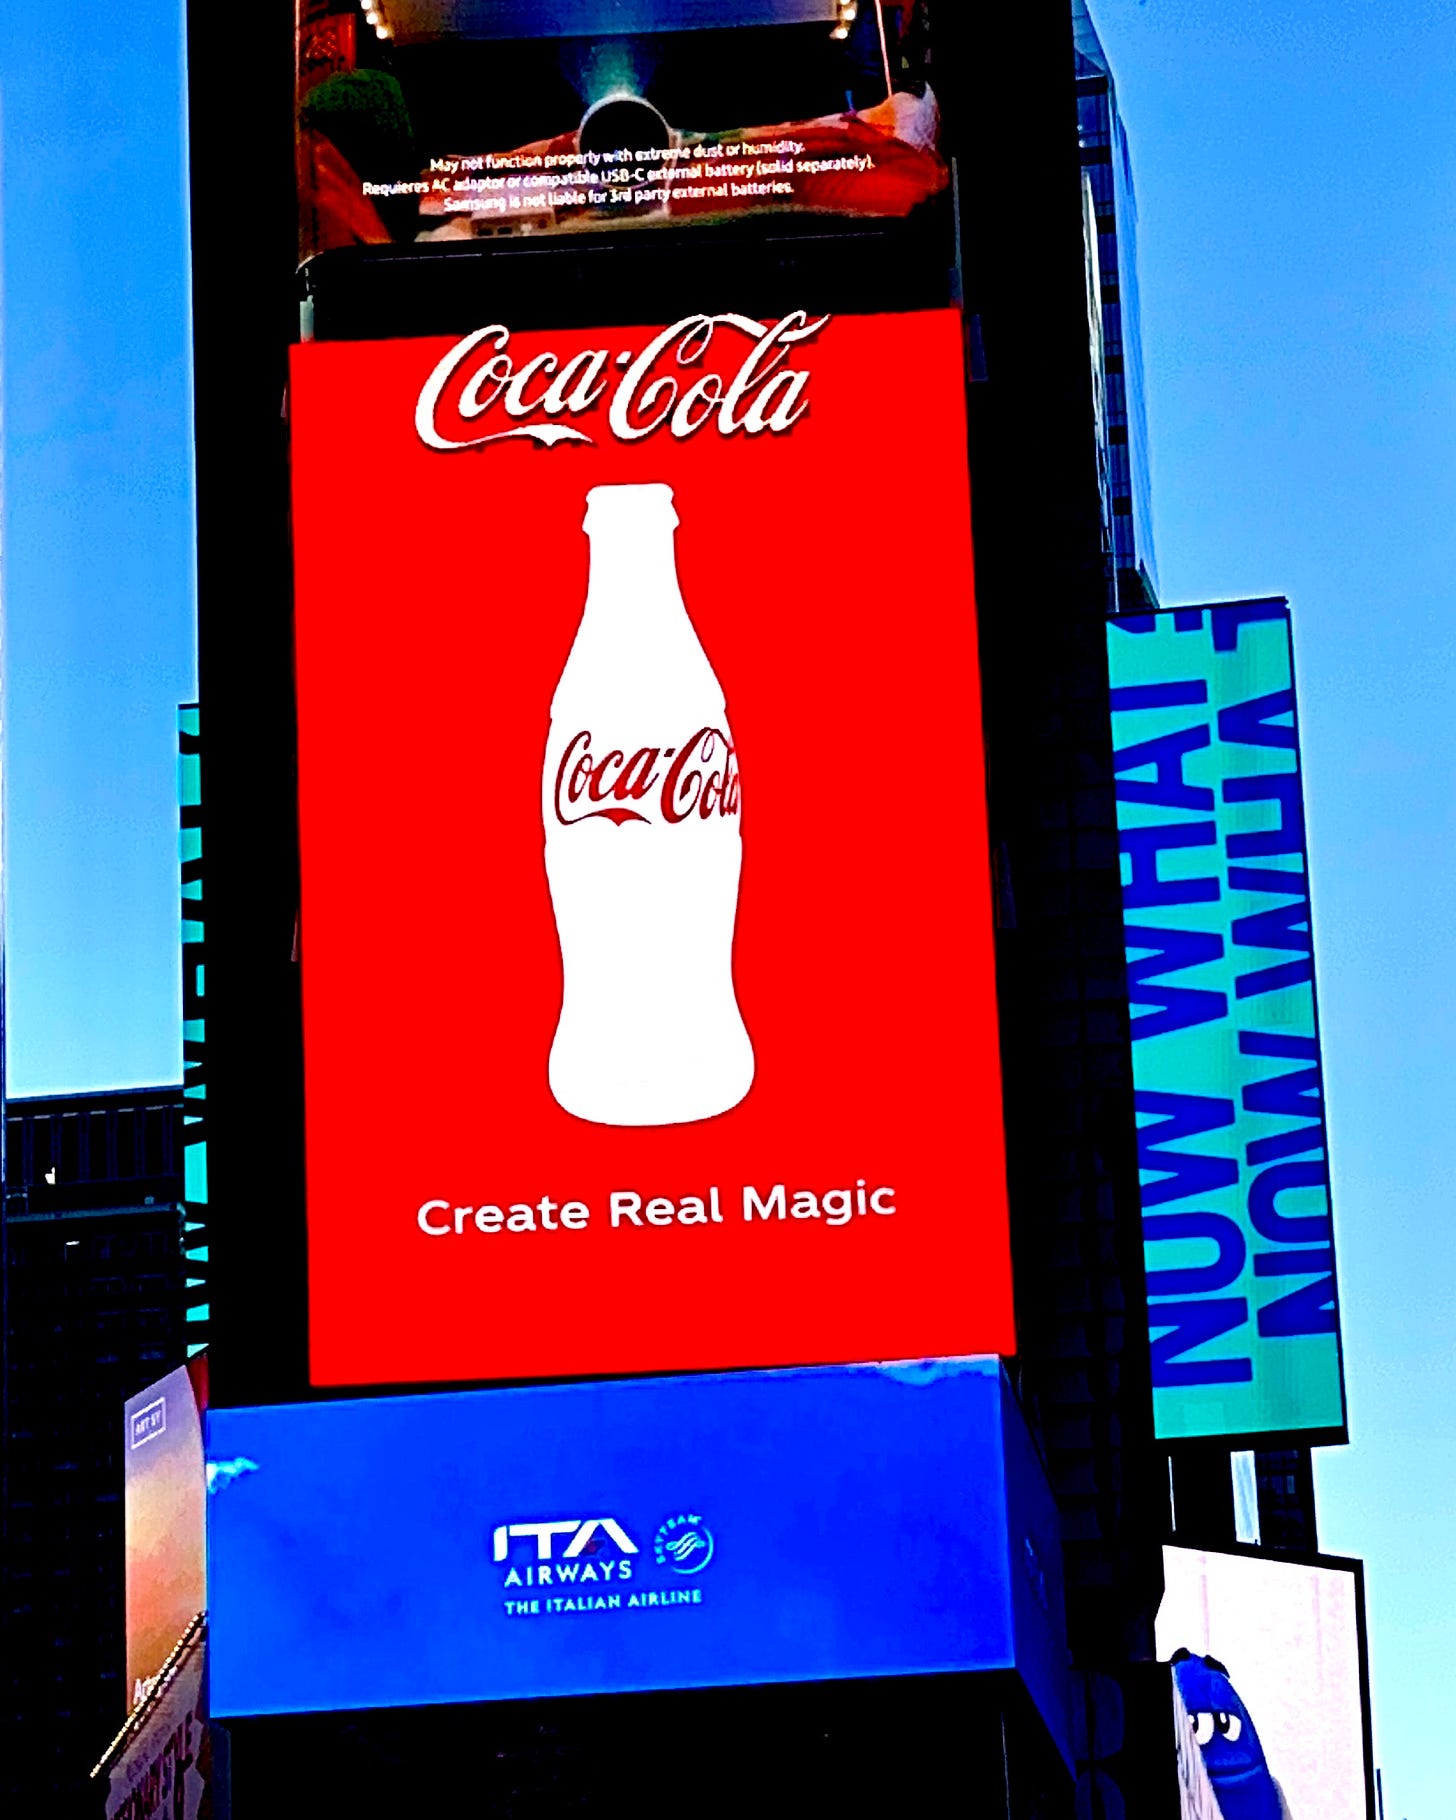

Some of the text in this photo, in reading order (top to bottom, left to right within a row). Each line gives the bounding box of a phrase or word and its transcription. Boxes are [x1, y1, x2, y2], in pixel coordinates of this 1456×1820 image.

[430, 158, 459, 174] May
[461, 157, 483, 170] not
[485, 154, 542, 171] function
[602, 148, 632, 163] with
[635, 147, 690, 162] extreme
[693, 144, 724, 158] dust
[726, 144, 741, 157] or
[742, 140, 805, 156] humidity.
[431, 178, 450, 192] AC
[507, 176, 521, 188] or
[523, 169, 599, 190] compatible
[601, 167, 644, 182] USB-C
[647, 164, 702, 180] external
[705, 161, 755, 179] battery
[443, 197, 507, 213] Samsung
[509, 195, 521, 209] is
[523, 193, 546, 208] not
[588, 188, 607, 204] for
[609, 187, 631, 203] 3rd
[634, 185, 671, 204] party
[672, 183, 729, 200] external
[731, 179, 795, 197] batteries.
[417, 1179, 897, 1236] Create Real Magic
[493, 1518, 639, 1562] ITA
[504, 1560, 632, 1588] AIRWAYS
[504, 1589, 702, 1616] THE ITALIAN AIRLINE
